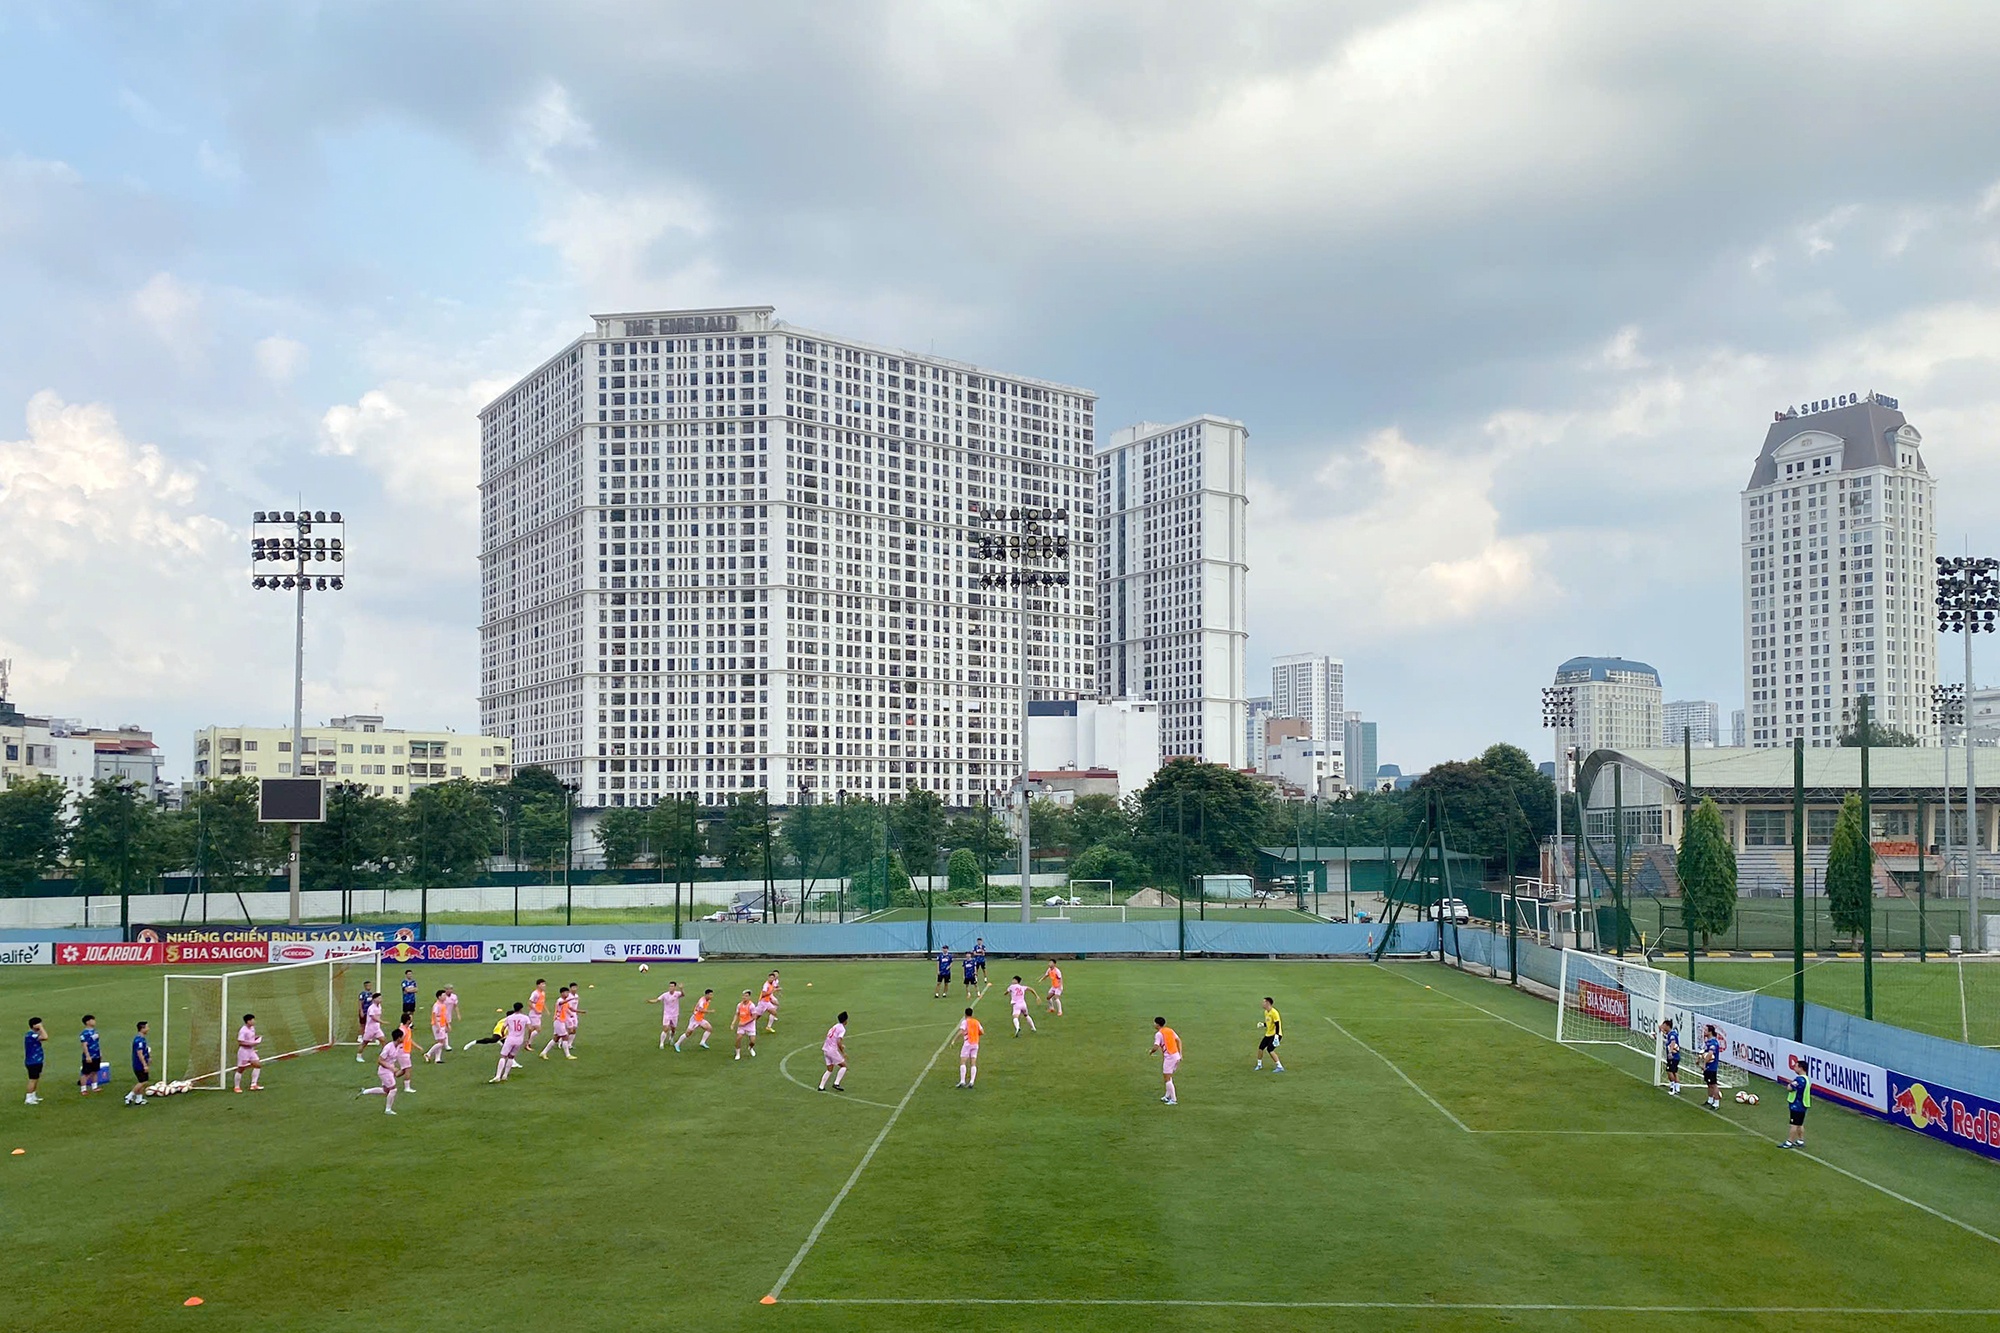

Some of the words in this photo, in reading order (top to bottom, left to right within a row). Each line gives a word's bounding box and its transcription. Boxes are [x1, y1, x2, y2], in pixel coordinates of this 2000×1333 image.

[624, 319, 653, 336] THE
[660, 315, 737, 335] EMERALD
[1801, 392, 1857, 415] SUDICO
[271, 931, 306, 942] BINH
[310, 931, 340, 941] SAO
[344, 928, 385, 942] VÀNG
[82, 946, 153, 961] JOGARBOLA
[183, 947, 209, 959] BIA
[211, 947, 263, 959] SAIGON
[428, 945, 452, 959] Red
[453, 945, 479, 959] Bull
[558, 943, 585, 953] TƯƠI
[623, 944, 681, 955] VFF.ORG.VN
[0, 949, 33, 963] alife
[1586, 991, 1599, 1010] BIA
[1600, 993, 1625, 1017] SAIGON
[513, 1019, 522, 1031] 16
[1732, 1040, 1775, 1070] MODERN
[1825, 1061, 1874, 1098] CHANNEL
[1952, 1100, 1987, 1144] Red
